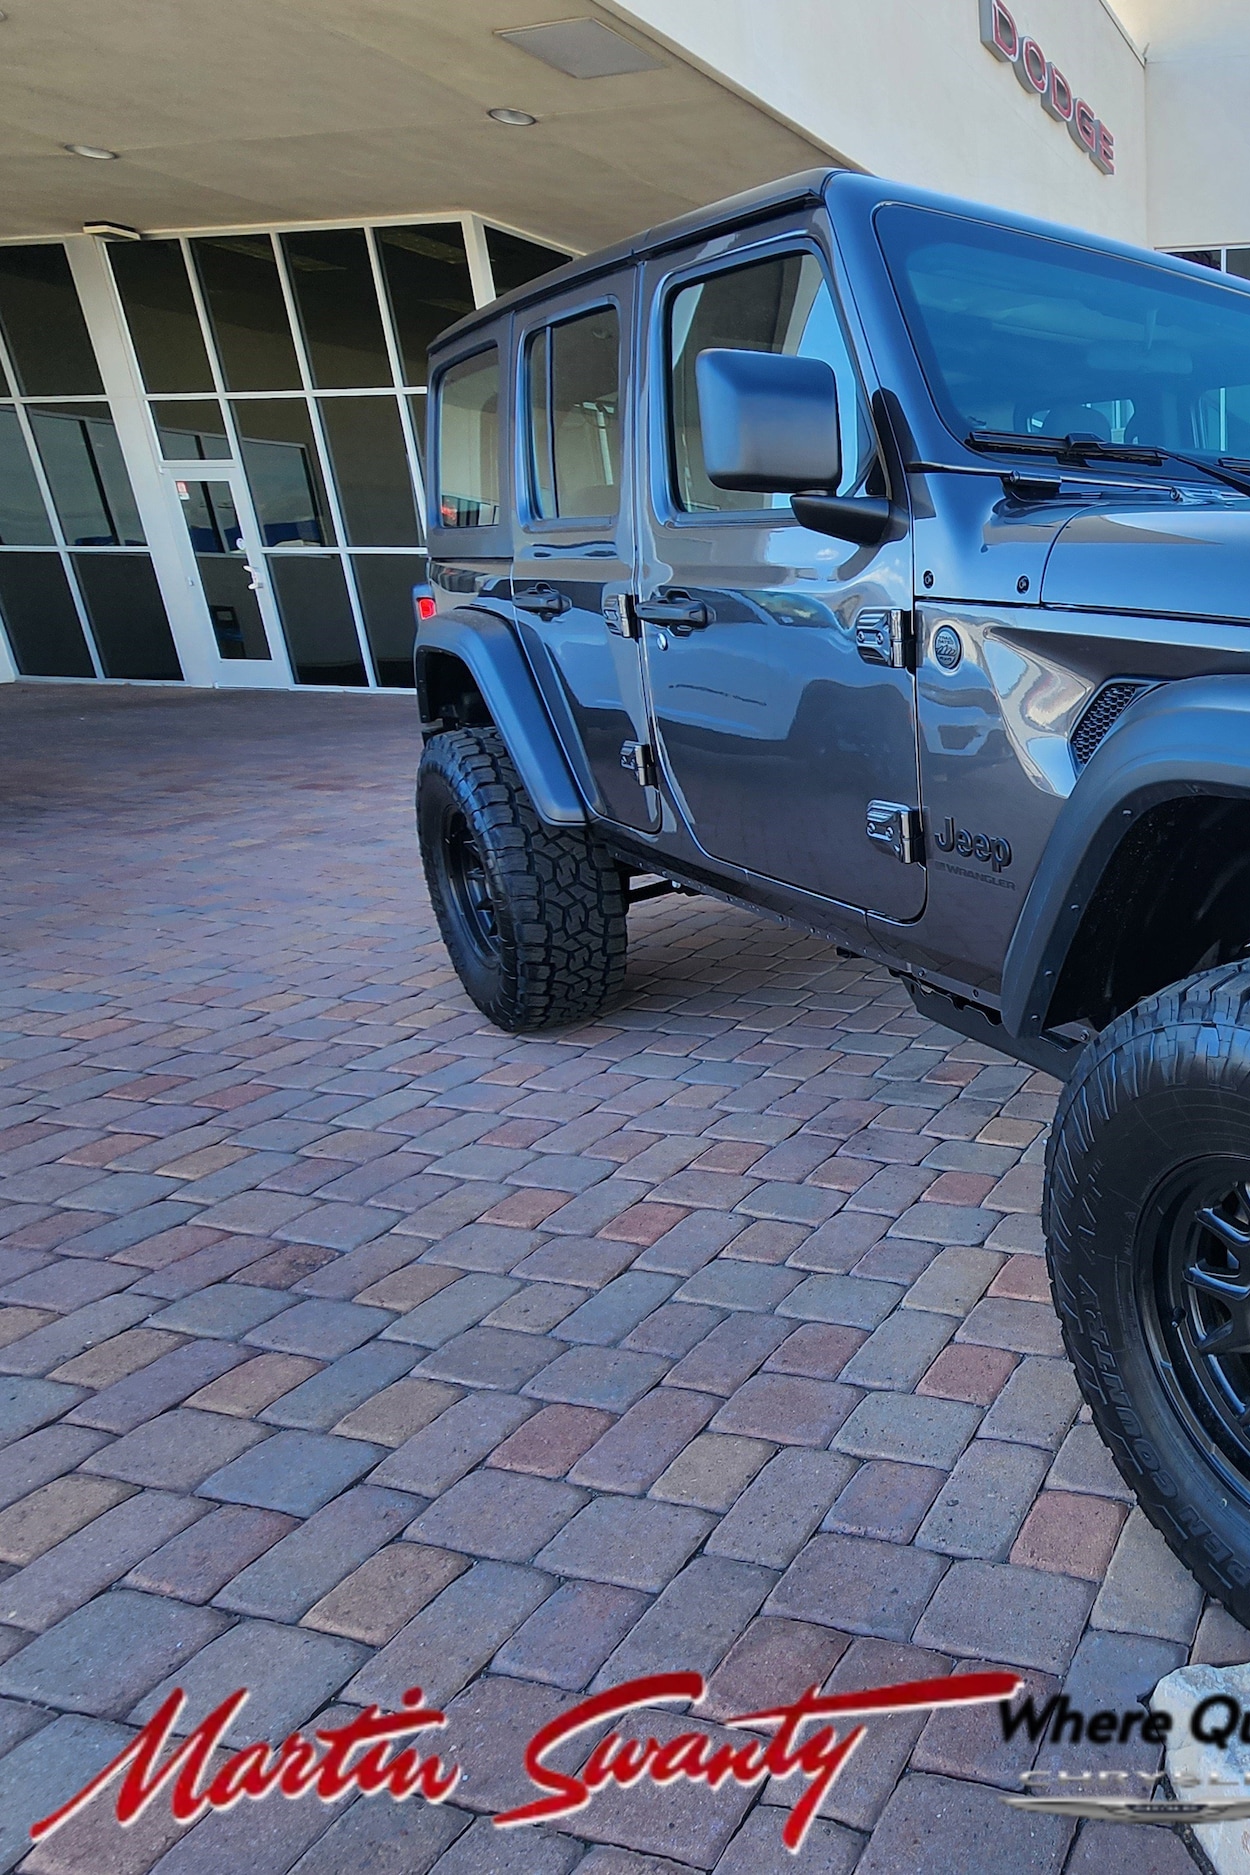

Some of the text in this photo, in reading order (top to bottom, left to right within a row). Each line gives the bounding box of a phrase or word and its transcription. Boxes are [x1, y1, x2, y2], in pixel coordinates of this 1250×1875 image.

[980, 0, 1115, 175] DODGE
[934, 816, 1013, 873] Jeep
[946, 863, 1017, 891] WRANGLER
[1078, 1274, 1179, 1499] COUNTRY
